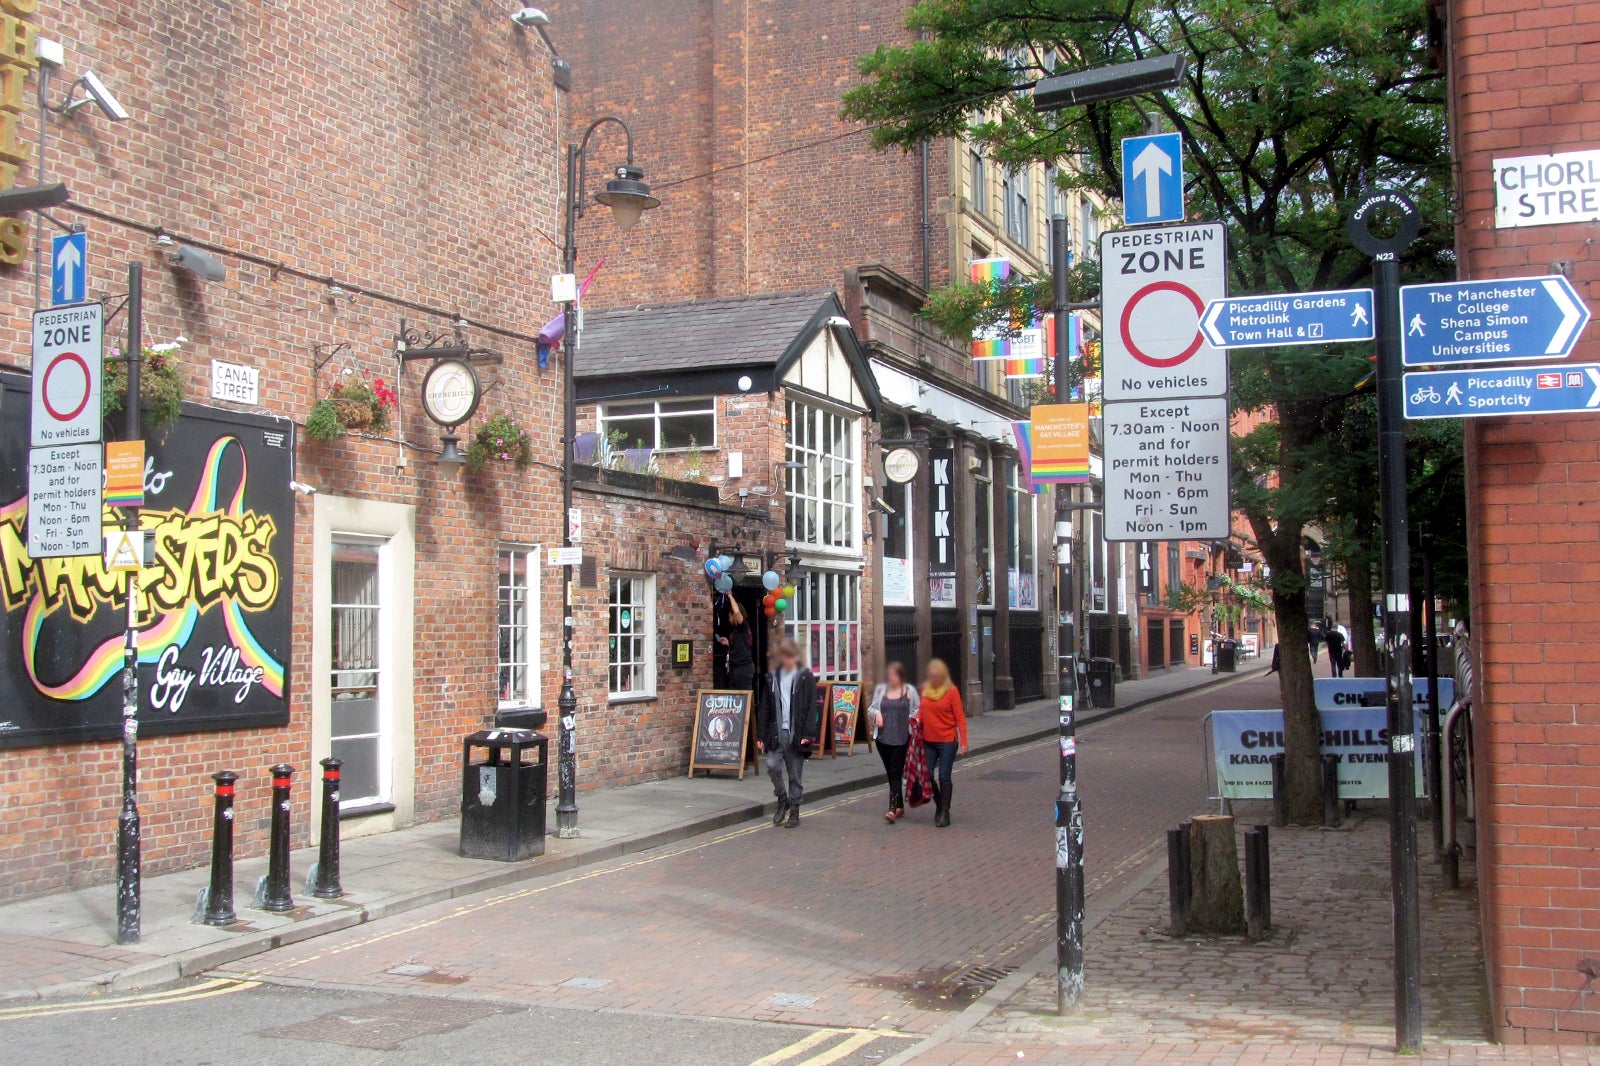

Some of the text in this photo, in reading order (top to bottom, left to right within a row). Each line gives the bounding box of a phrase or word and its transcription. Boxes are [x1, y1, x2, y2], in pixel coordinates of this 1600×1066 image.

[1500, 160, 1600, 190] CHORL
[1354, 194, 1412, 220] Chorlton Street
[1518, 188, 1598, 218] STRE
[1112, 229, 1214, 248] PEDESTRIAN
[1121, 248, 1205, 274] ZONE
[1376, 252, 1394, 260] N23
[1429, 286, 1536, 303] The Manchester
[1230, 297, 1346, 314] Piccadilly Gardens
[1458, 303, 1508, 314] College
[40, 310, 96, 326] PEDESTRIAN
[1230, 312, 1290, 326] Metrolink
[1441, 315, 1528, 329] Shena Simon
[44, 325, 90, 347] ZONE
[1230, 330, 1262, 340] Town
[1267, 327, 1292, 338] Hall
[1297, 327, 1306, 337] &
[1454, 330, 1508, 342] Campus
[1432, 342, 1510, 356] Universities
[218, 366, 254, 384] CANAL
[1122, 376, 1208, 390] No vehicles
[1468, 376, 1532, 389] Piccadilly
[216, 382, 254, 400] STREET
[1468, 395, 1531, 408] Sportcity
[1140, 406, 1190, 418] Except
[42, 427, 90, 439] No vehicles
[1111, 424, 1164, 435] 7.30am
[1182, 421, 1219, 432] Noon
[1139, 438, 1190, 450] and for
[51, 450, 80, 460] Except
[1113, 454, 1219, 470] permit holders
[33, 464, 65, 474] 7.30am
[74, 462, 96, 471] Noon
[143, 456, 174, 494] to
[49, 475, 80, 486] and for
[1130, 473, 1160, 483] Mon
[1175, 471, 1202, 482] Thu
[34, 488, 96, 500] permit holders
[1124, 489, 1160, 500] Noon
[1178, 487, 1208, 500] 6pm
[43, 503, 62, 512] Mon
[70, 501, 86, 510] Thu
[934, 459, 950, 563] KIKI
[1136, 504, 1153, 516] Fri
[1170, 504, 1197, 515] Sun
[40, 516, 62, 525] Noon
[71, 514, 90, 524] 6pm
[1126, 521, 1163, 532] Noon
[1180, 520, 1207, 533] 1pm
[46, 529, 57, 538] Fri
[67, 528, 83, 536] Sun
[41, 542, 63, 551] Noon
[73, 541, 89, 550] 1pm
[150, 644, 263, 712] Gay Village
[706, 696, 742, 713] guilty
[1241, 729, 1388, 749] CHUHILLS
